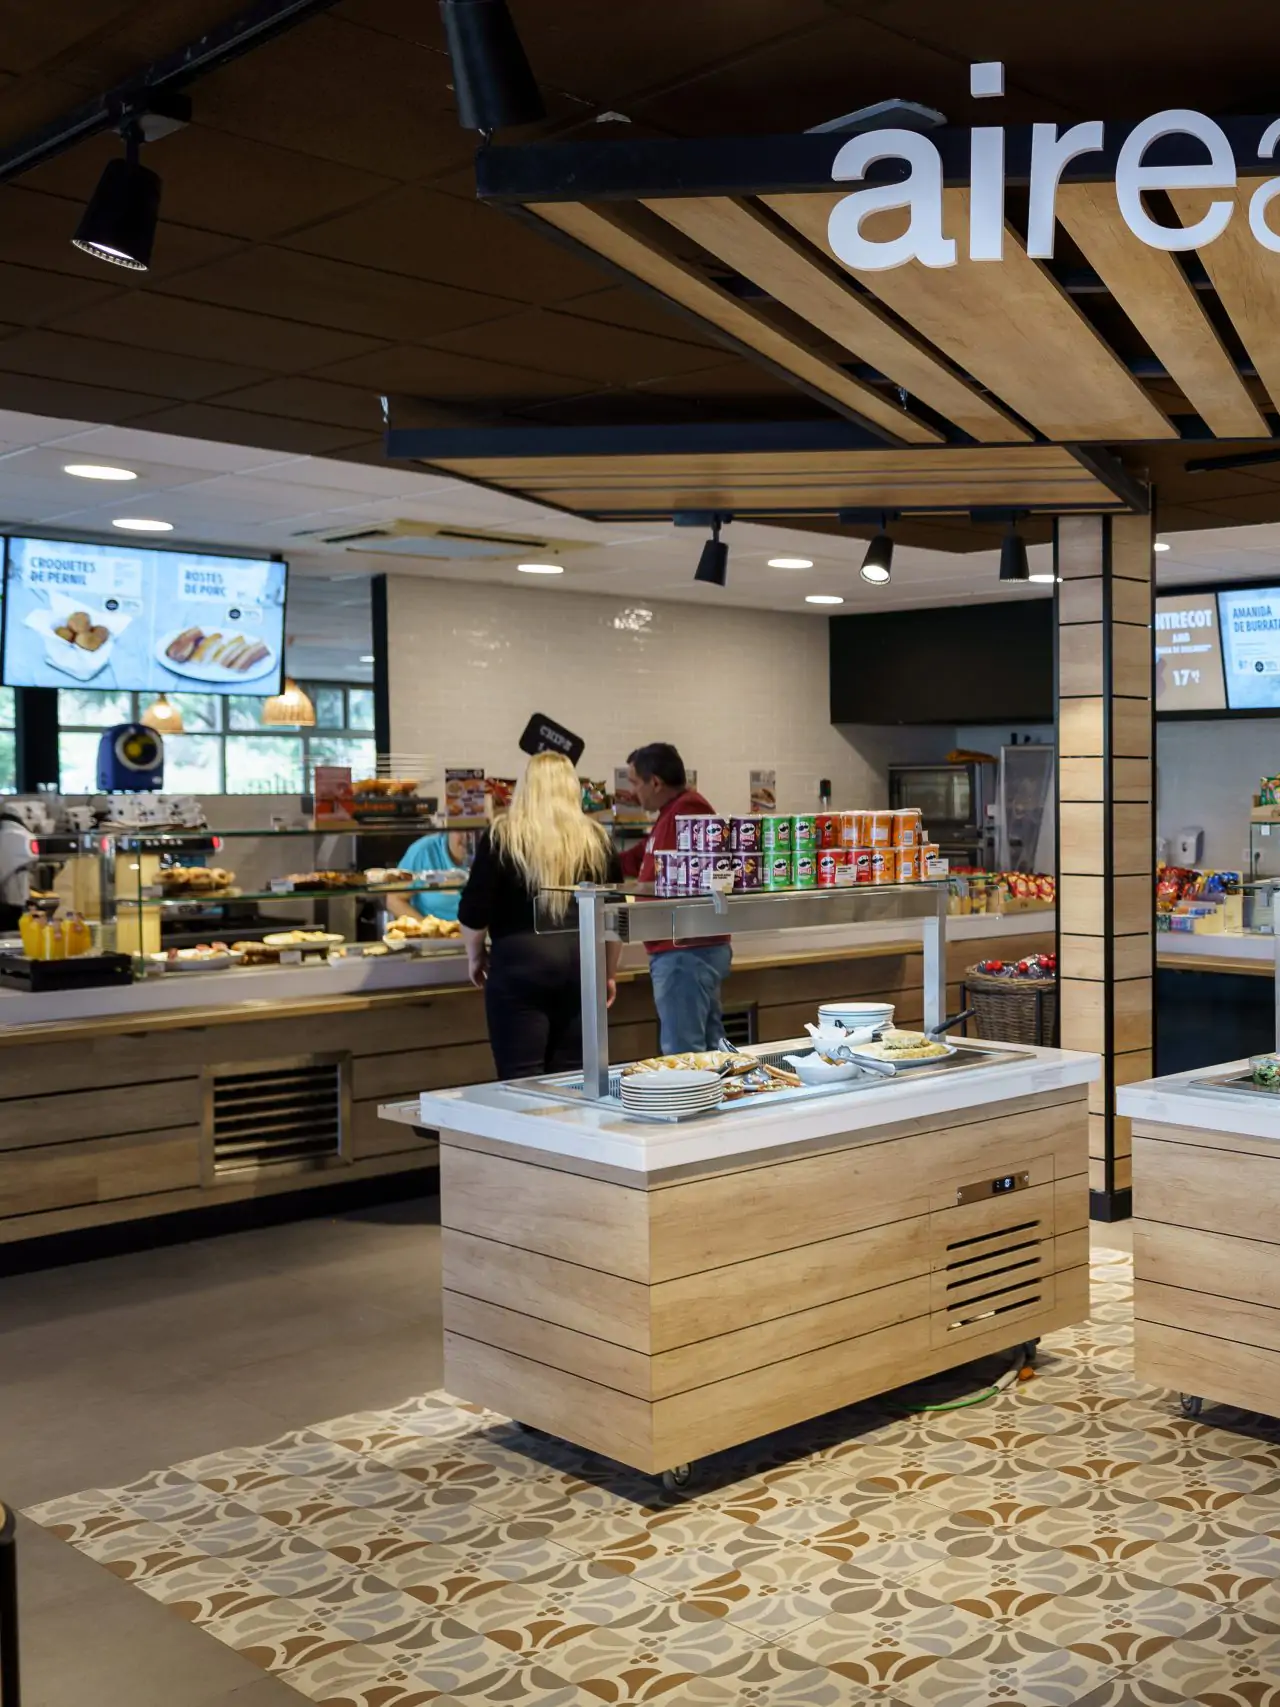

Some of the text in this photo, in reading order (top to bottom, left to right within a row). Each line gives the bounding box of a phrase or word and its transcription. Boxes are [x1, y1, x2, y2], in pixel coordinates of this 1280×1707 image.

[30, 557, 96, 573] CROQUETES
[1233, 605, 1272, 619] AMANIDA
[1155, 609, 1212, 631] NTRECOT
[1234, 621, 1245, 633] DE
